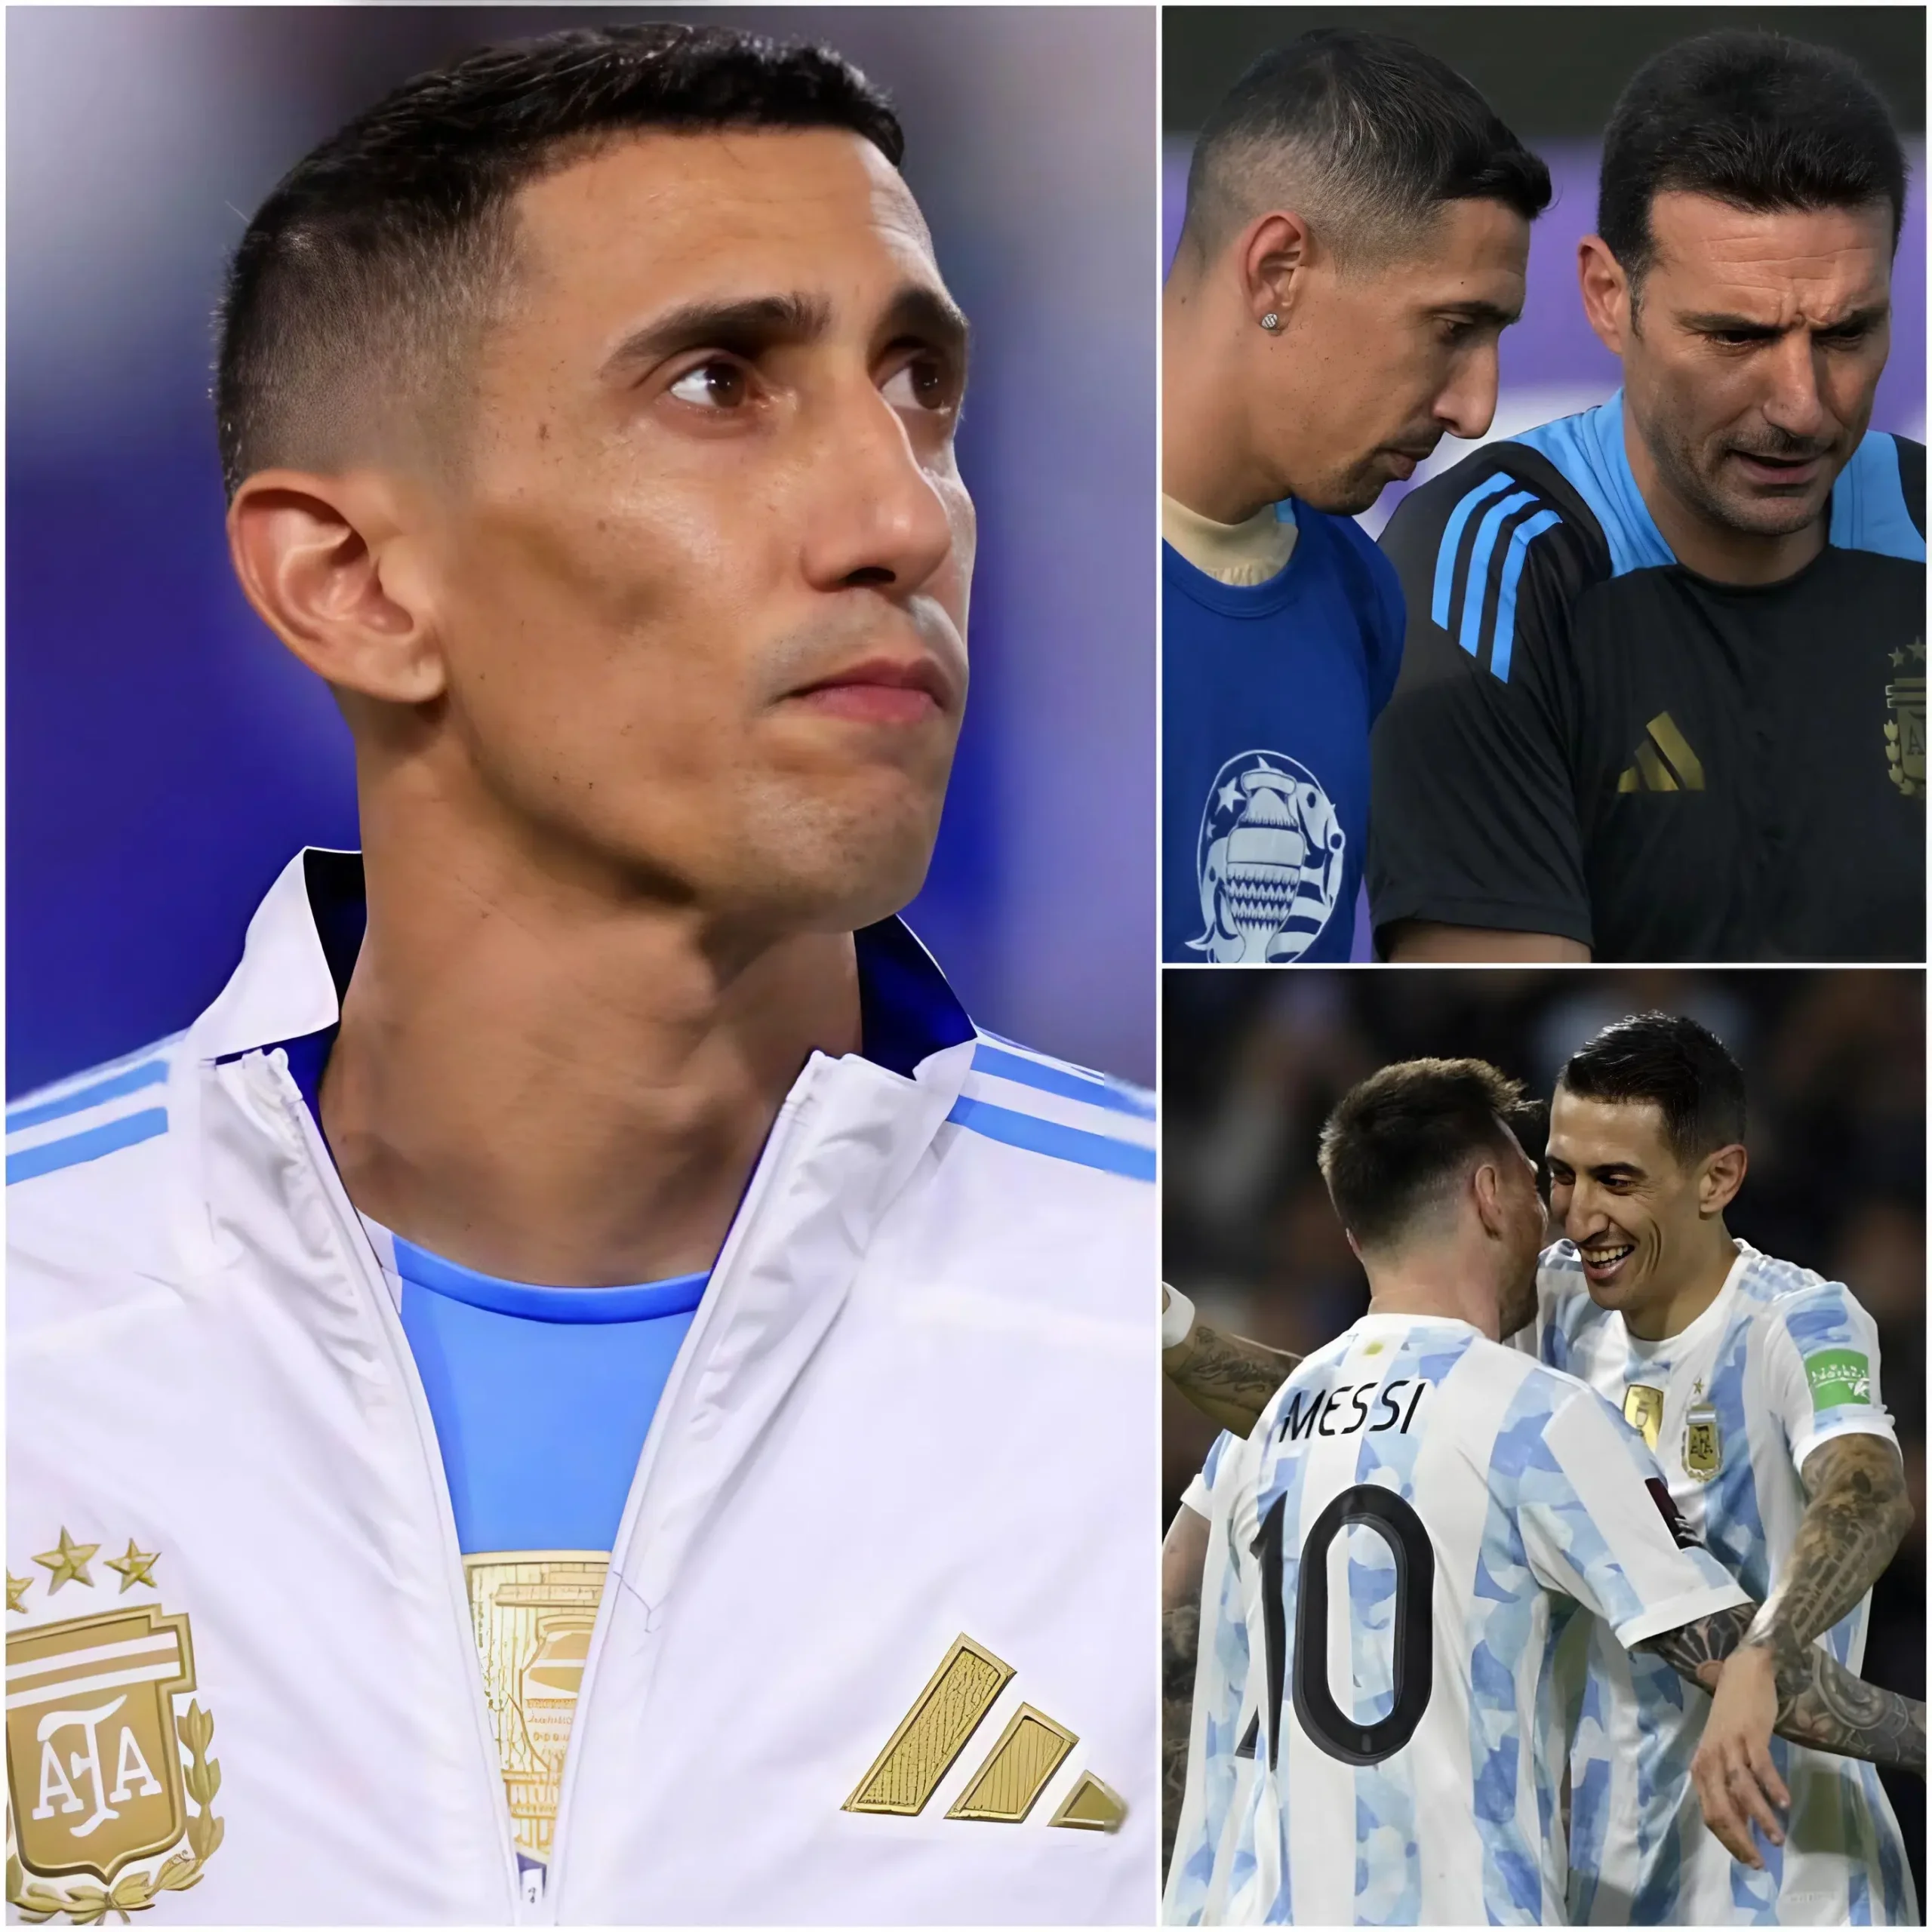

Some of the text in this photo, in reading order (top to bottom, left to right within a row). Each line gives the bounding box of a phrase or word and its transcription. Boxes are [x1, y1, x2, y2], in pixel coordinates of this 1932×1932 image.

[1278, 1380, 1426, 1443] MESSI
[1235, 1484, 1435, 1772] 10
[32, 1694, 163, 1838] AFA
